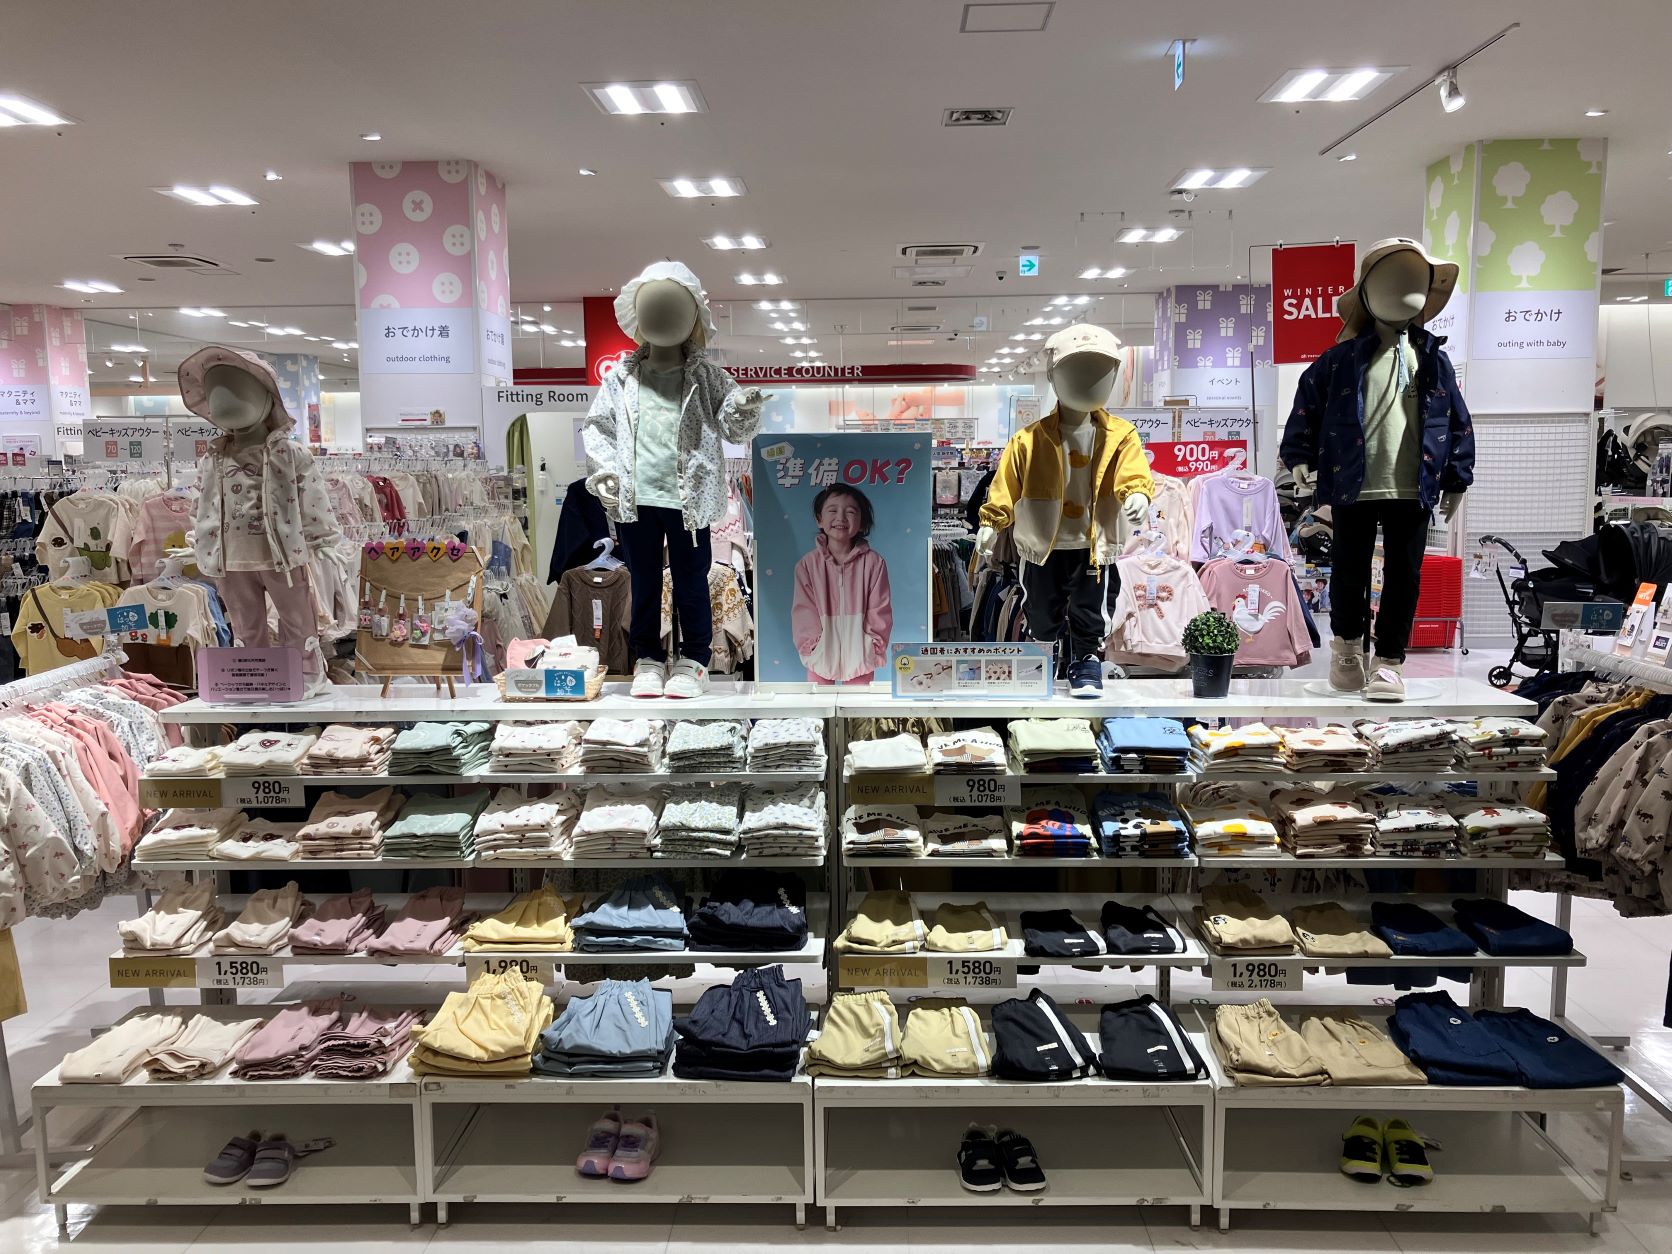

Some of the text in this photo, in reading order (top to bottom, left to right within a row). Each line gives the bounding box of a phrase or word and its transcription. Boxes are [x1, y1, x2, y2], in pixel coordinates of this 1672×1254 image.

[1284, 285, 1345, 297] WINTER
[1504, 308, 1563, 323] おでかけ
[384, 325, 451, 339] おでかけ着
[1497, 339, 1567, 349] outing with baby
[386, 354, 451, 364] outdoor clothing
[730, 365, 863, 378] SERVICE COUNTER
[1208, 377, 1241, 387] イベント
[496, 390, 589, 406] Fitting Room
[87, 427, 160, 438] ベビーキッズアウター
[1174, 443, 1219, 462] 900円
[367, 545, 461, 558] ヘアアクセ
[251, 781, 290, 795] 980円
[857, 785, 927, 794] NEW ARRIVAL
[966, 778, 1006, 793] 980円
[146, 790, 214, 799] NEW ARRIVAL
[117, 969, 188, 978] NEW ARRIVAL
[215, 961, 268, 976] 1,580円
[847, 968, 920, 977] NEW ARRIVAL
[947, 960, 1002, 975] 1,580円
[1231, 963, 1287, 978] 1,980円
